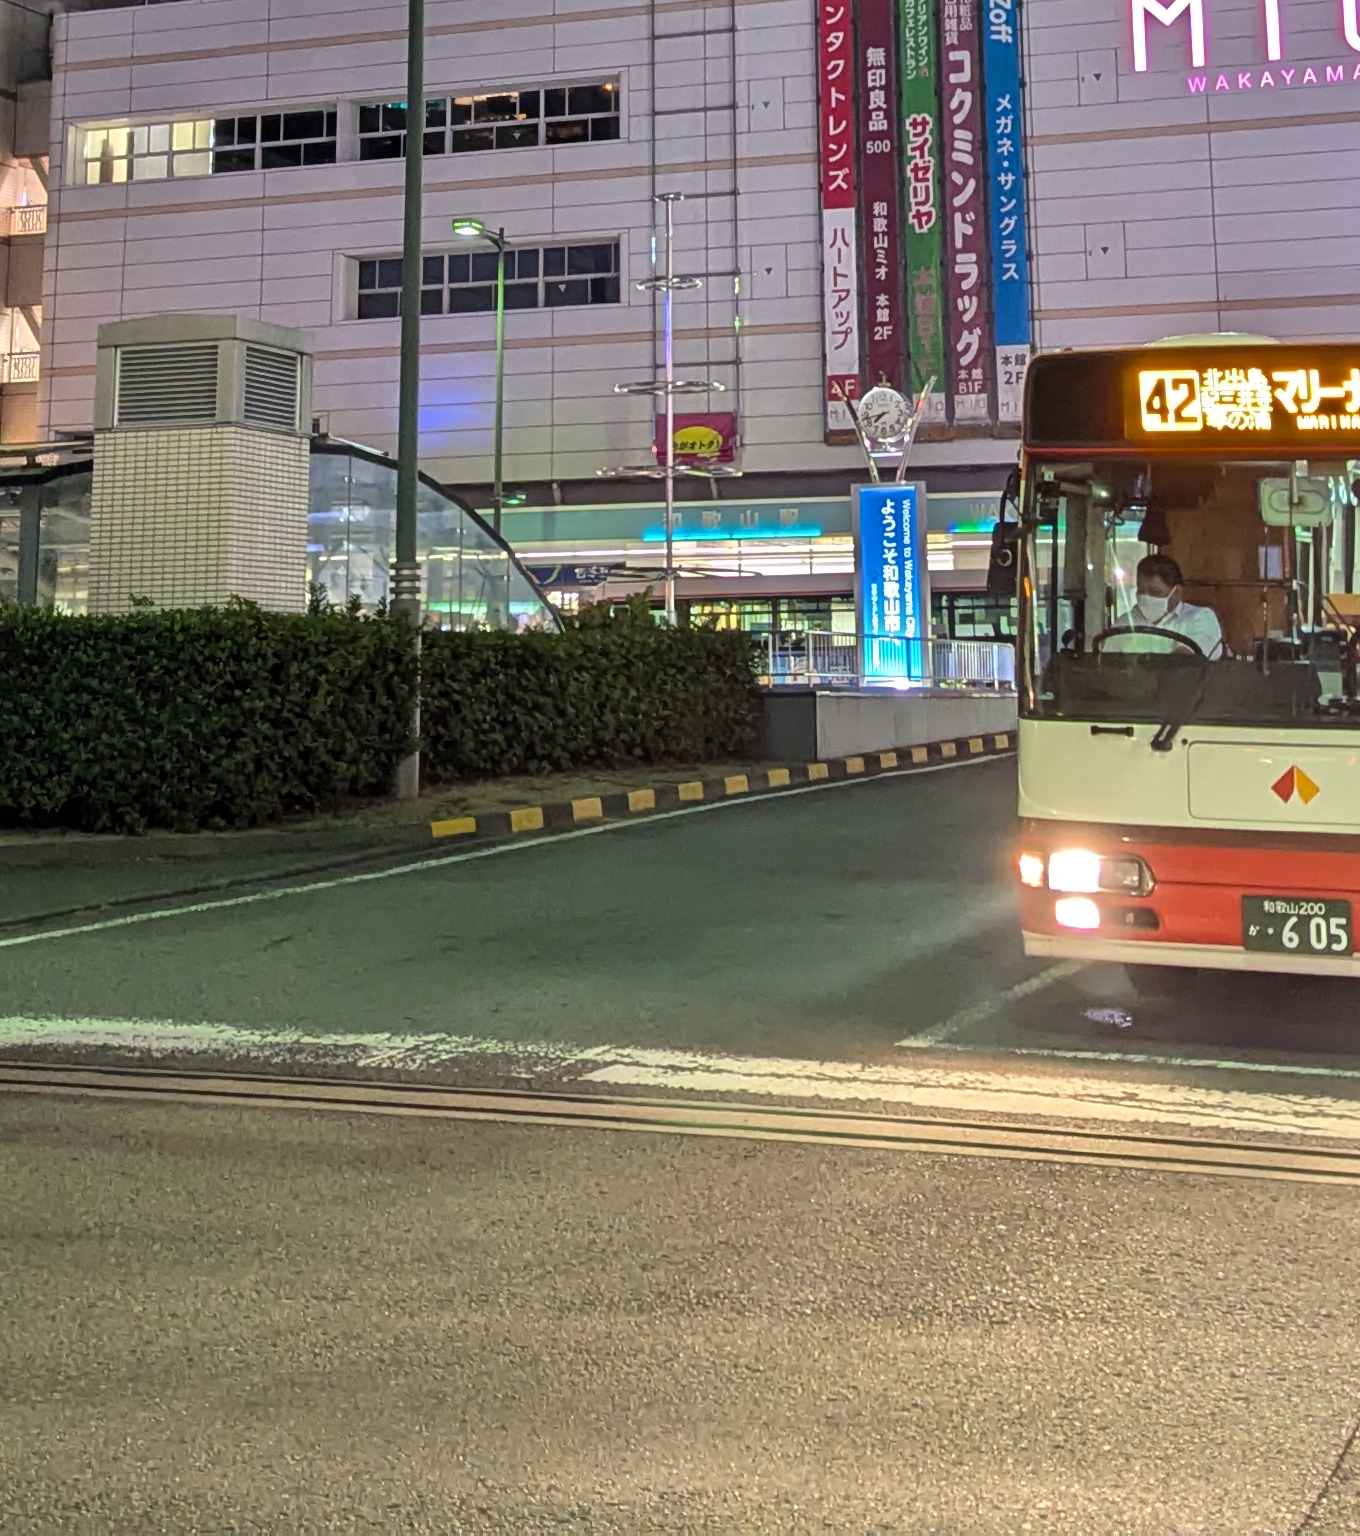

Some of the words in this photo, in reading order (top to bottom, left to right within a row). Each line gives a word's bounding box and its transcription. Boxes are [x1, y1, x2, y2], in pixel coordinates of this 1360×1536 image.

[866, 46, 888, 132] 無印良品
[866, 140, 891, 154] 500
[906, 113, 937, 233] サイゼリヤ
[995, 94, 1020, 281] メガネ・サングラス
[949, 50, 982, 366] コクミンドラッグ
[872, 202, 889, 281] 和歌山ミオ
[829, 227, 853, 351] ハートアップ
[957, 367, 983, 380] 本館
[1001, 353, 1027, 366] 本館
[1003, 370, 1025, 385] 2F
[958, 380, 983, 394] B1F
[1145, 377, 1198, 423] 42
[902, 498, 911, 545] Welcome
[904, 547, 912, 558] to
